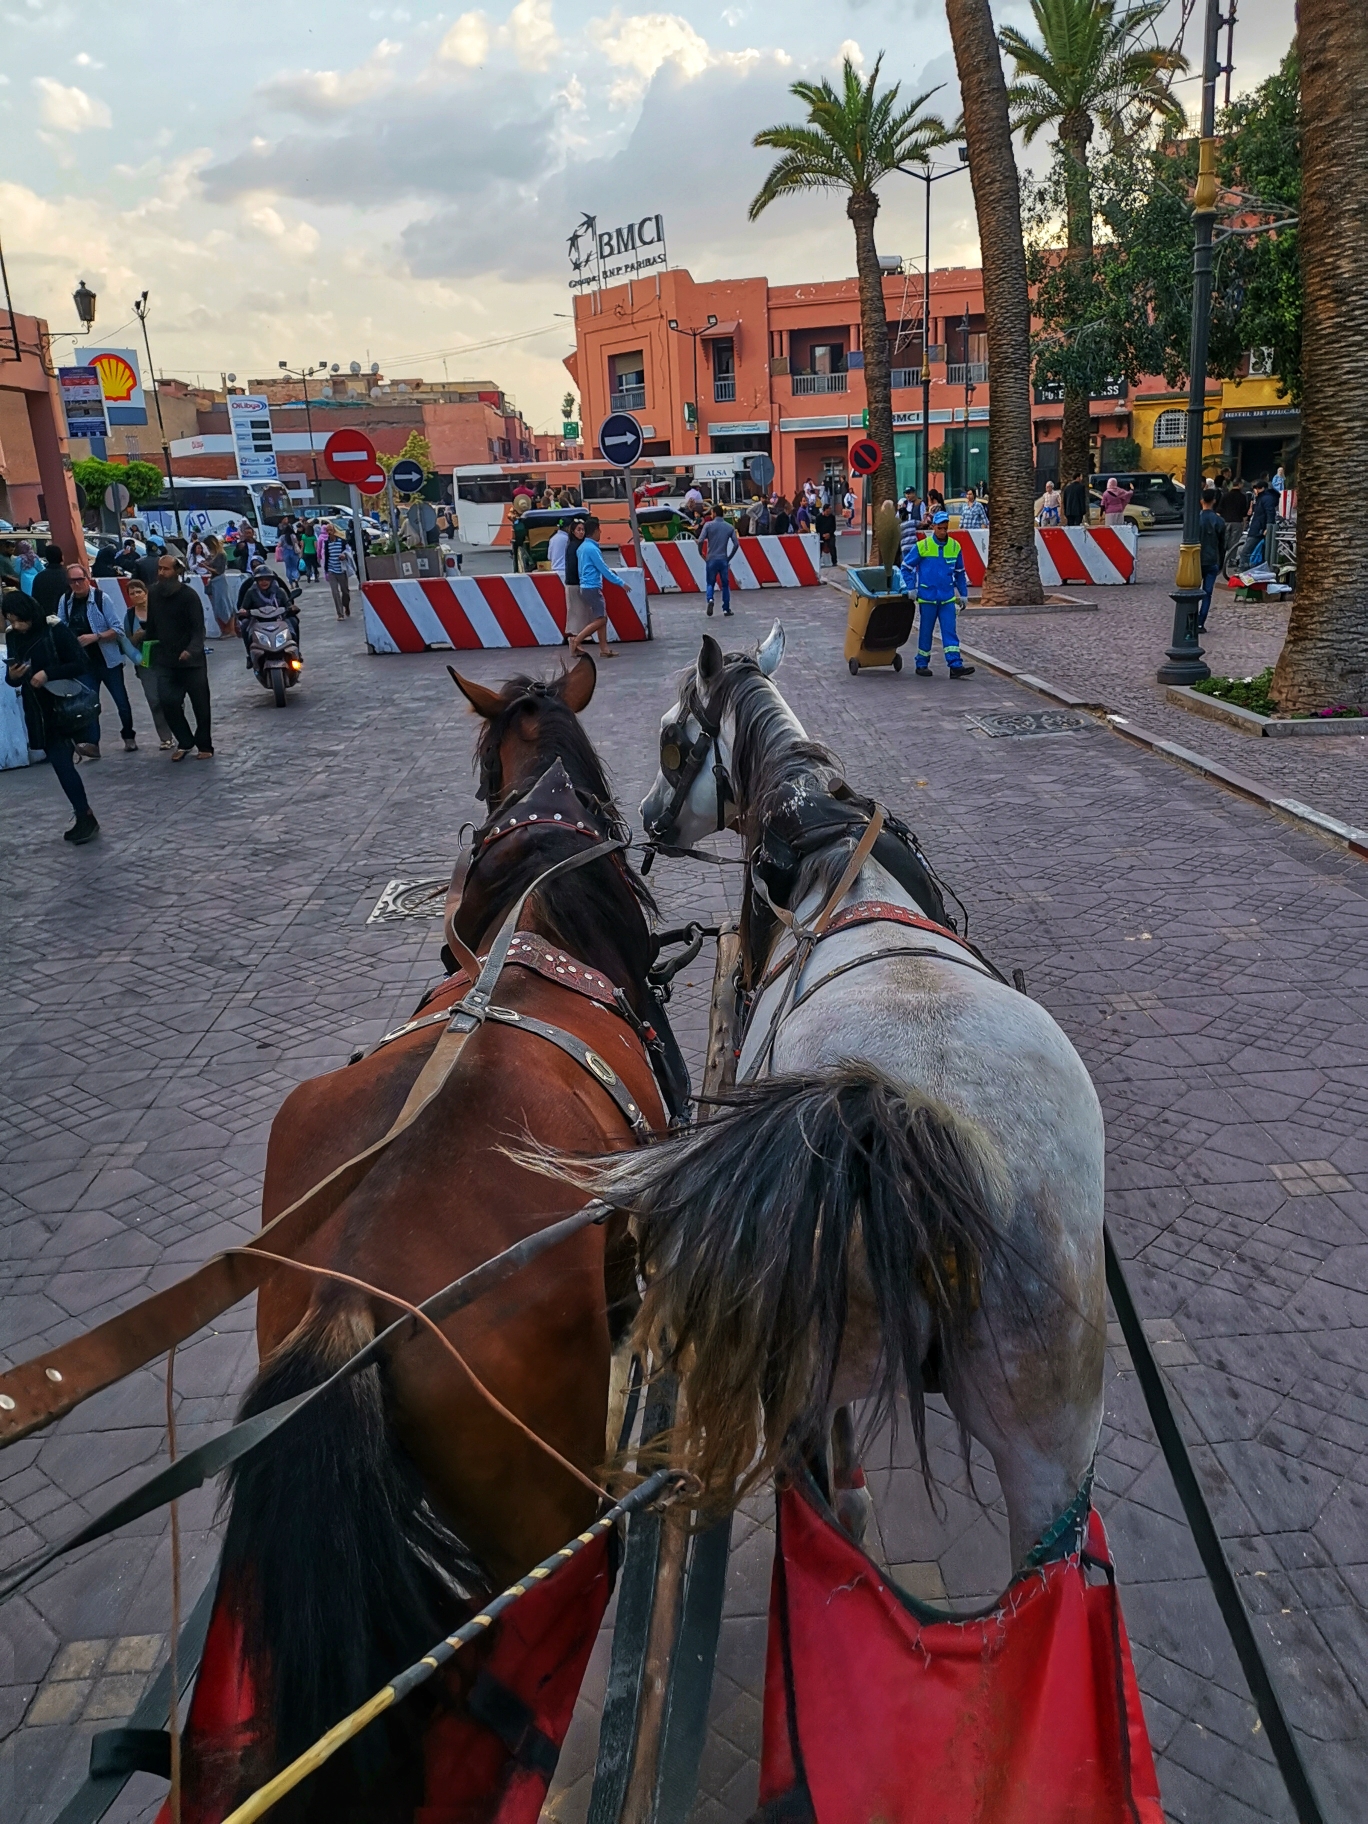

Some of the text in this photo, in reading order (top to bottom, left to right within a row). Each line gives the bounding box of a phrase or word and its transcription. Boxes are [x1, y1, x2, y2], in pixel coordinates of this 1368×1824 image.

[598, 214, 665, 260] BMCI
[602, 267, 623, 279] BNP
[624, 253, 666, 274] PARIBAS
[706, 469, 727, 477] ALSA
